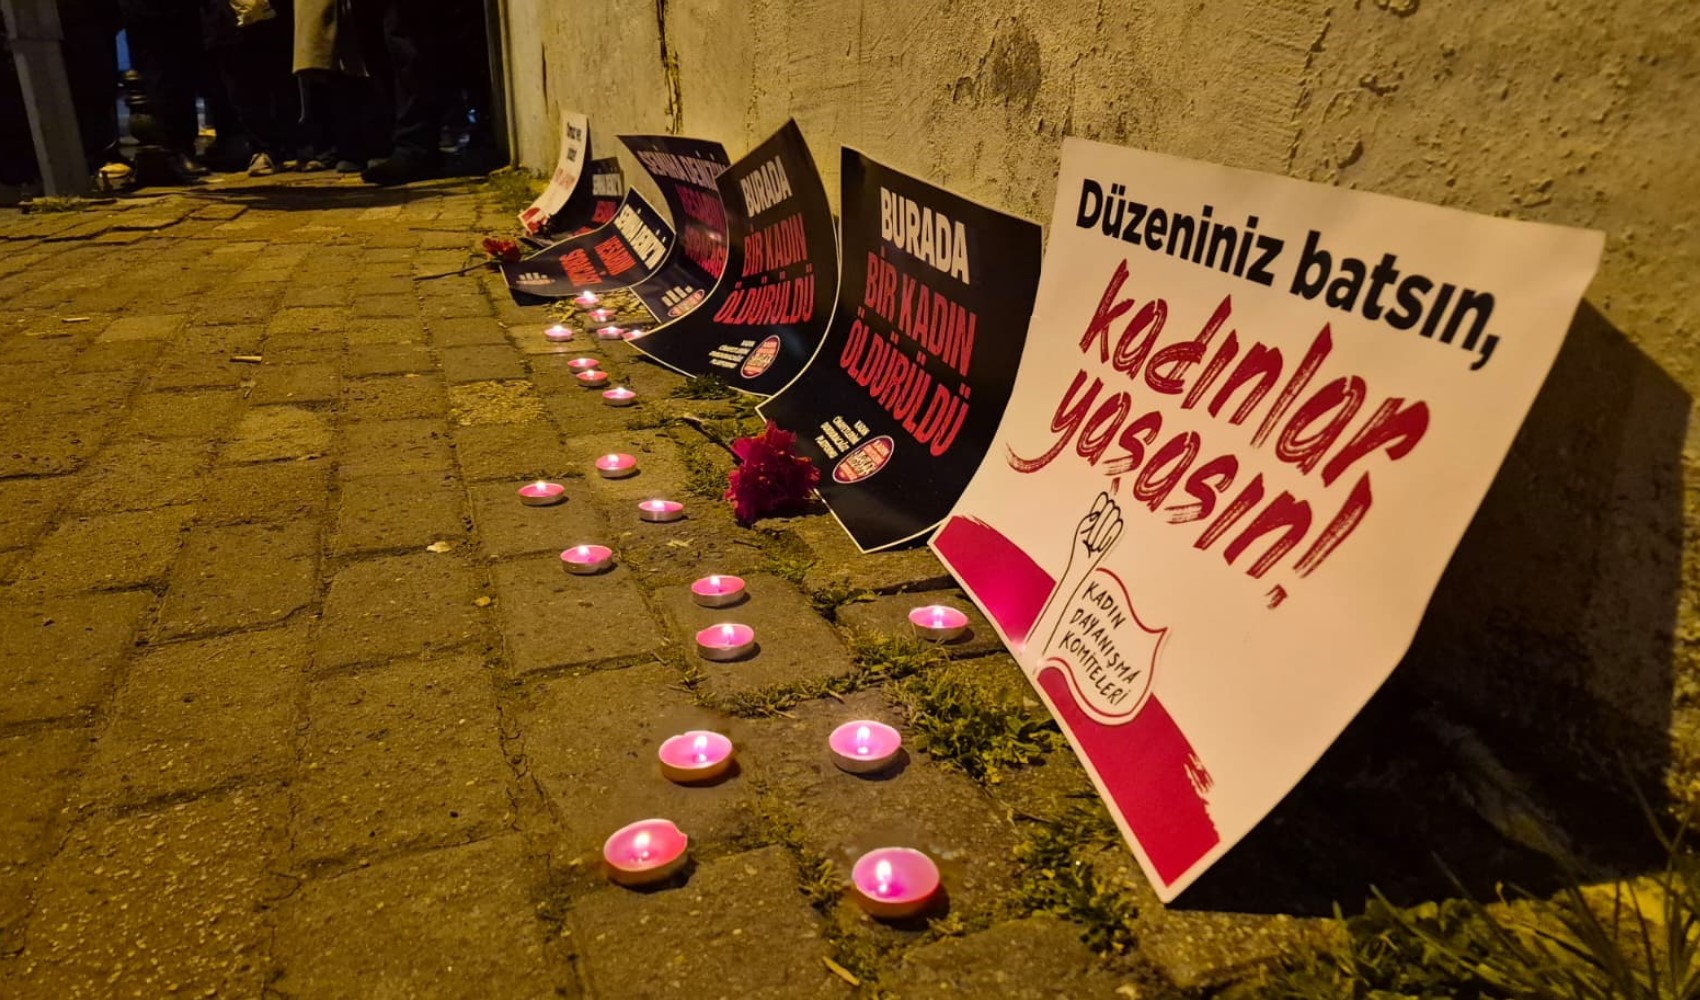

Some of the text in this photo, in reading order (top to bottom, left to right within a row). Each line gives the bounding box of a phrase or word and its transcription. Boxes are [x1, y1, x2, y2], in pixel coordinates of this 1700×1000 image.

[740, 155, 793, 218] BURADA
[744, 212, 808, 277] BİR KADIN
[881, 186, 970, 285] BURADA
[1076, 178, 1502, 372] Düzeniniz batsın,
[713, 263, 815, 325] ÖLDÜRÜLDÜ
[865, 246, 977, 377] BİR KADIN
[840, 305, 972, 457] ÖLDÜRÜLDÜ
[1079, 258, 1430, 488] kadınlar
[1006, 369, 1373, 610] yaşasın!
[1069, 608, 1141, 684] DAYANIŞMA
[1082, 581, 1126, 630] KADIN
[1058, 630, 1132, 706] KOMİTELERİ
